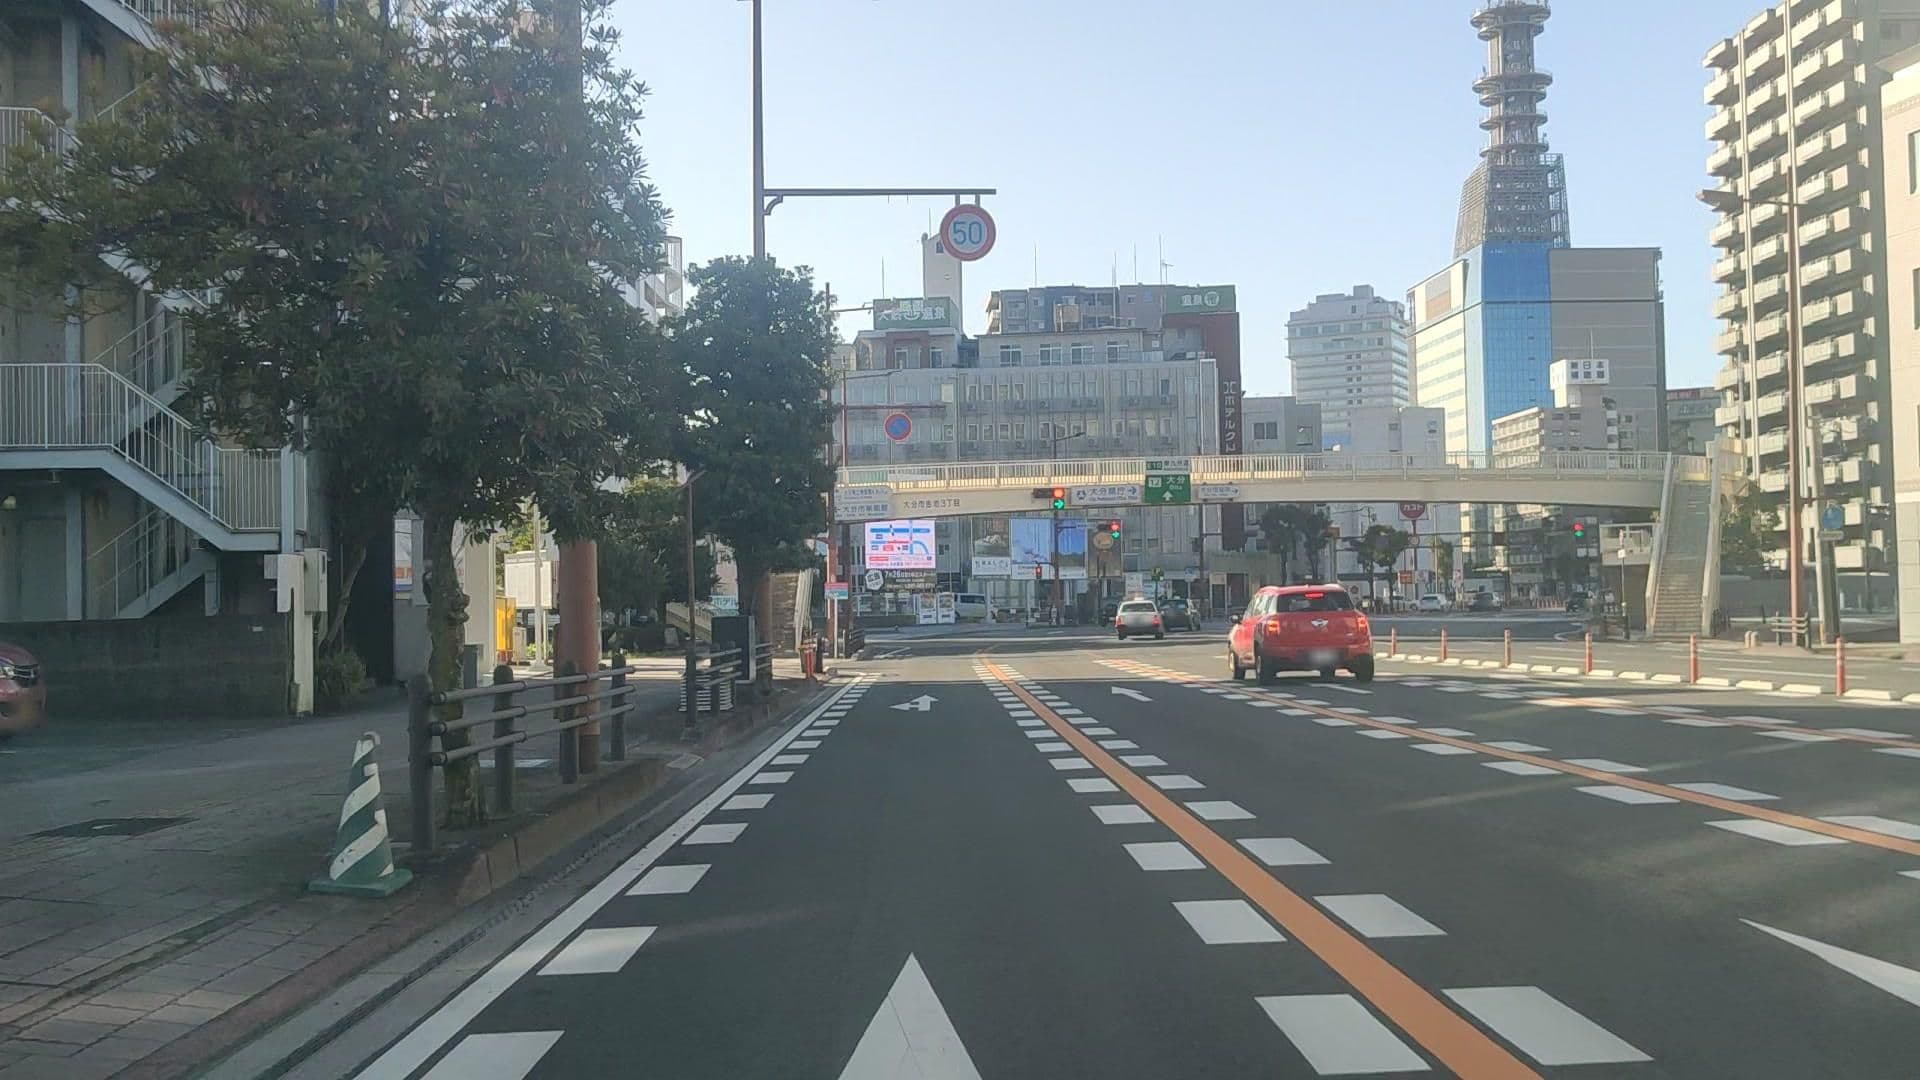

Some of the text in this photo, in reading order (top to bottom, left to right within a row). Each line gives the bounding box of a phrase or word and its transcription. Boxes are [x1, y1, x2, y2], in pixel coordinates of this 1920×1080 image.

[953, 220, 983, 245] 50
[1166, 476, 1185, 485] 大分
[1089, 486, 1126, 496] 大分県庁
